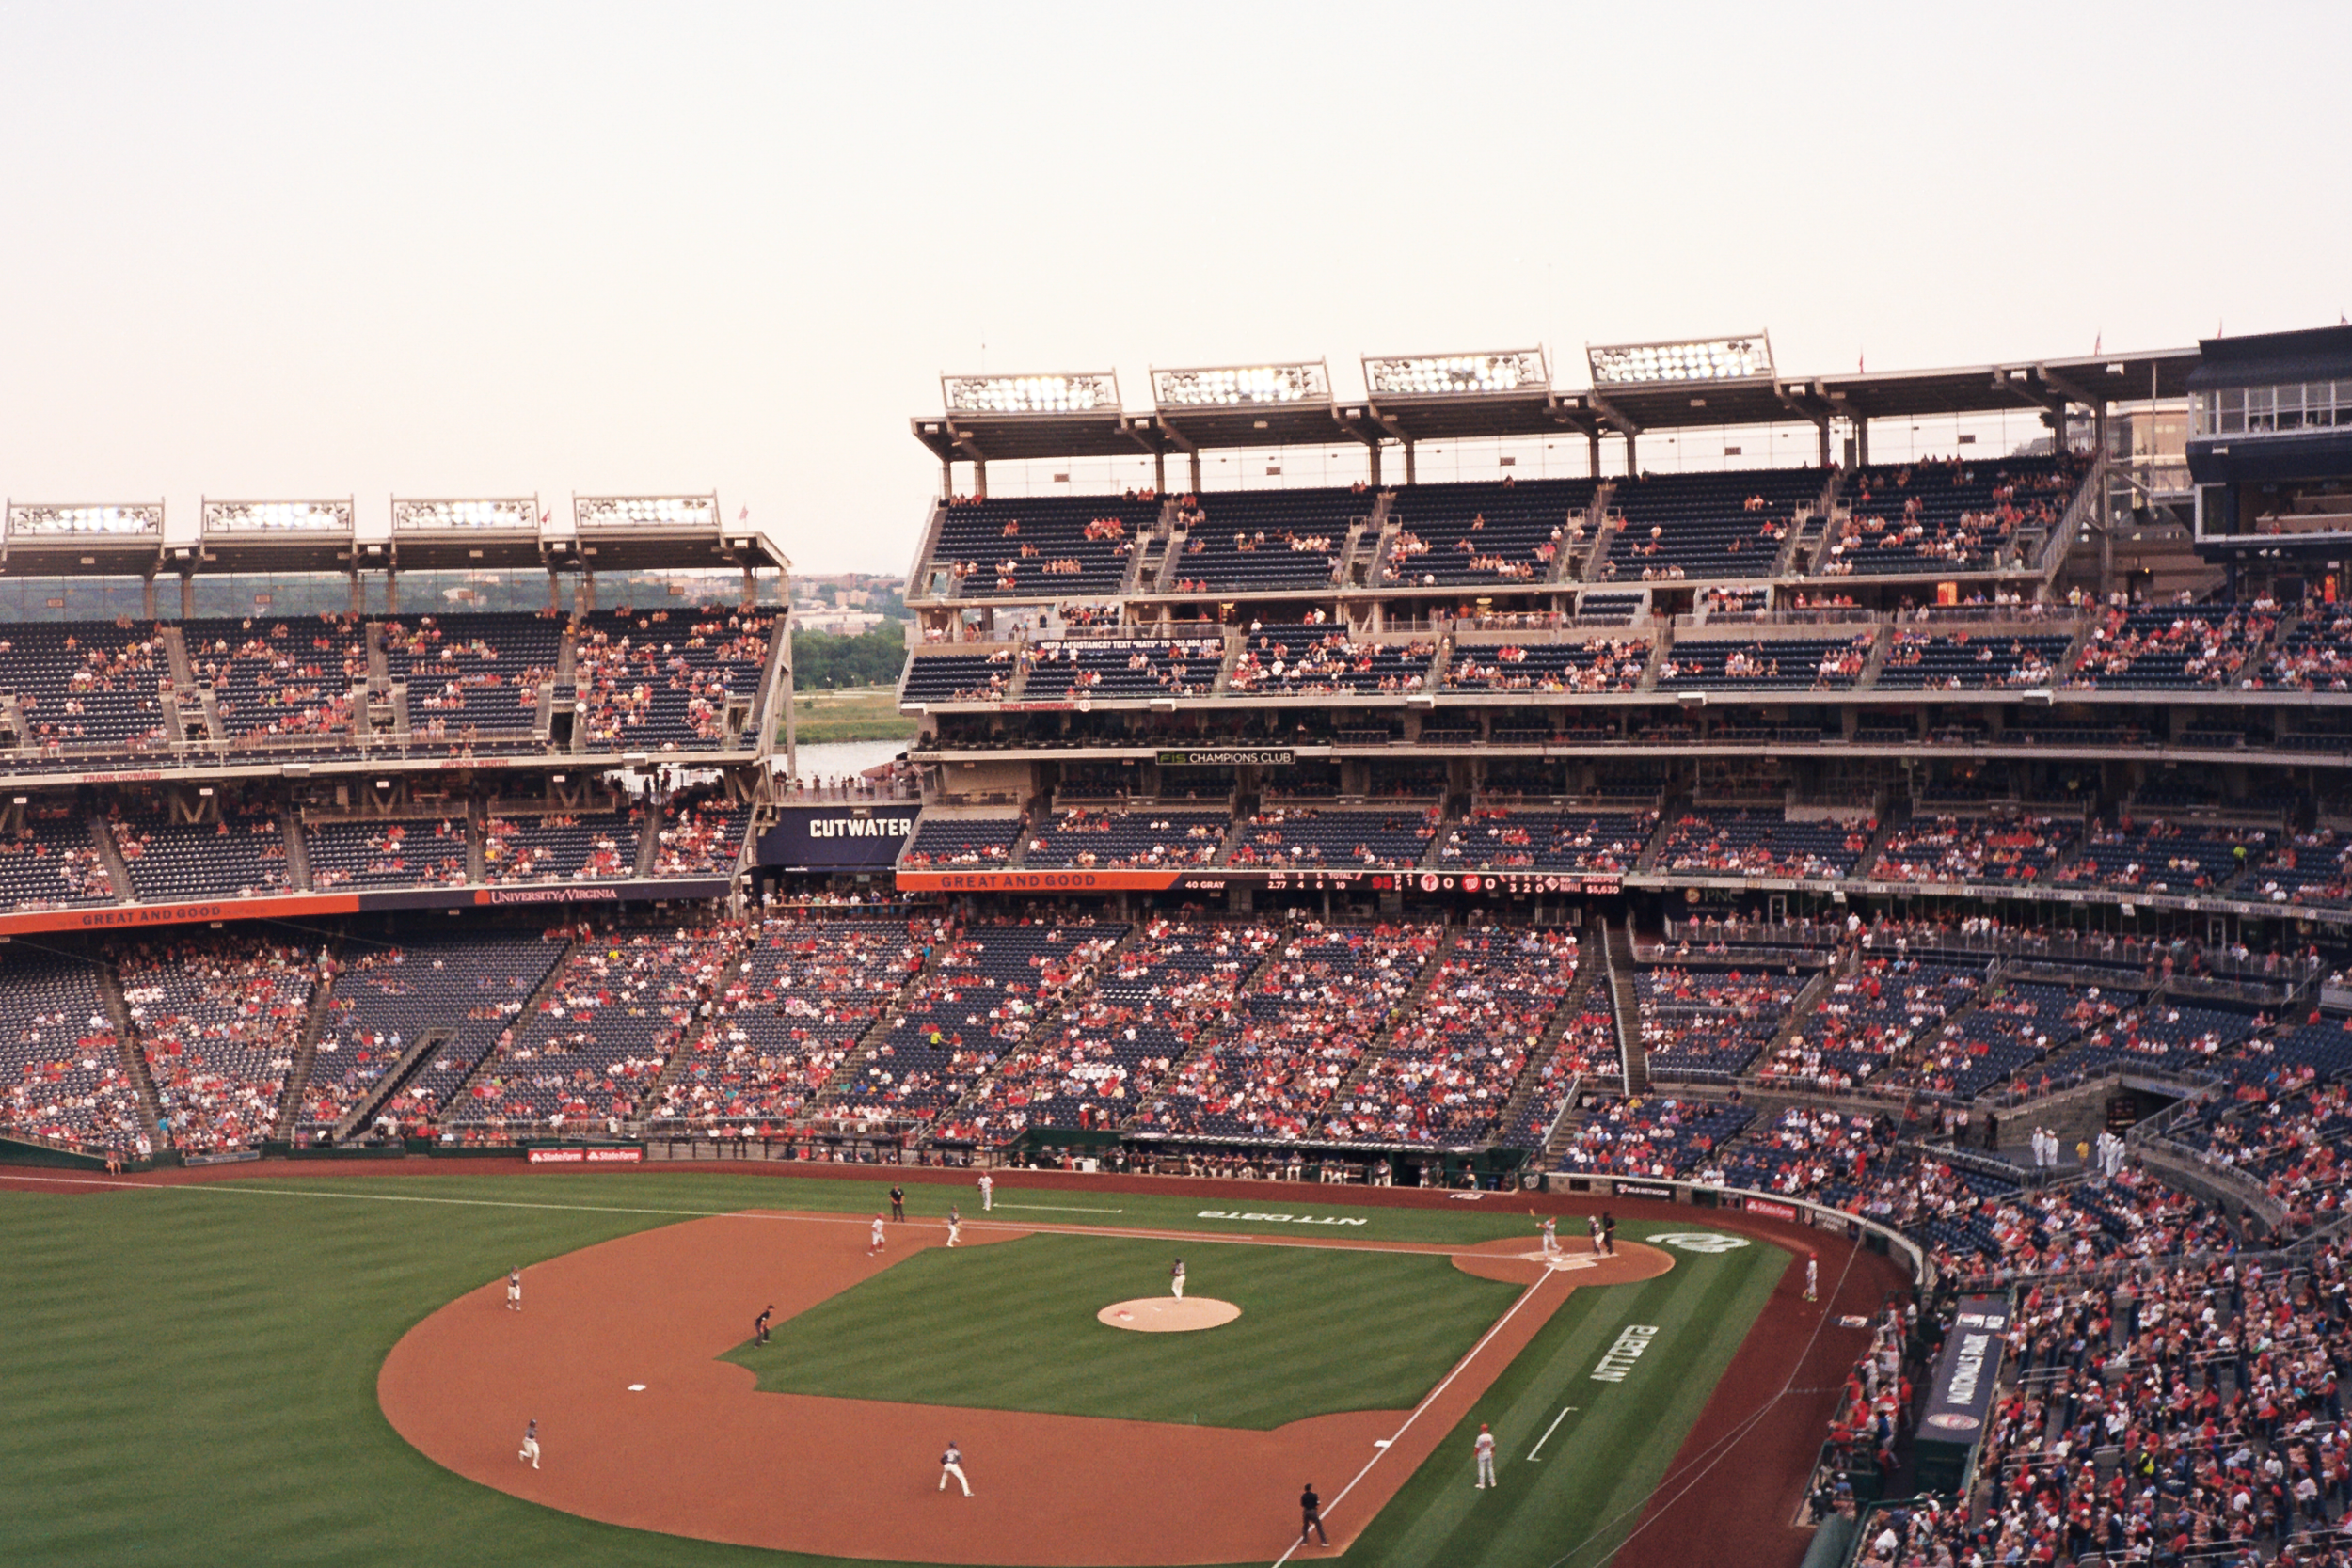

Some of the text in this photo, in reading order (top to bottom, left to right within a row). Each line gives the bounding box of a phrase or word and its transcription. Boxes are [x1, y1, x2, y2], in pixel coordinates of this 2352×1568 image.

[1160, 640, 1170, 648] TO
[1189, 752, 1259, 763] CHAMPIONS
[1260, 752, 1292, 763] CLUB
[83, 771, 161, 783] FRANK HOWARD
[810, 818, 912, 837] CUTWATER
[942, 875, 997, 888] GREAT
[1003, 875, 1039, 887] AND
[1045, 874, 1096, 887] GOOD
[1372, 876, 1393, 890] 95
[1443, 877, 1454, 889] 0
[1485, 877, 1496, 889] 0
[1581, 875, 1619, 883] JACKPOT
[1509, 883, 1544, 893] 3 2 0
[491, 890, 560, 904] UNIVERSITY
[565, 888, 617, 901] VIRGINIA
[83, 912, 134, 926] GREAT
[141, 910, 172, 921] AND
[176, 906, 221, 919] GOOD
